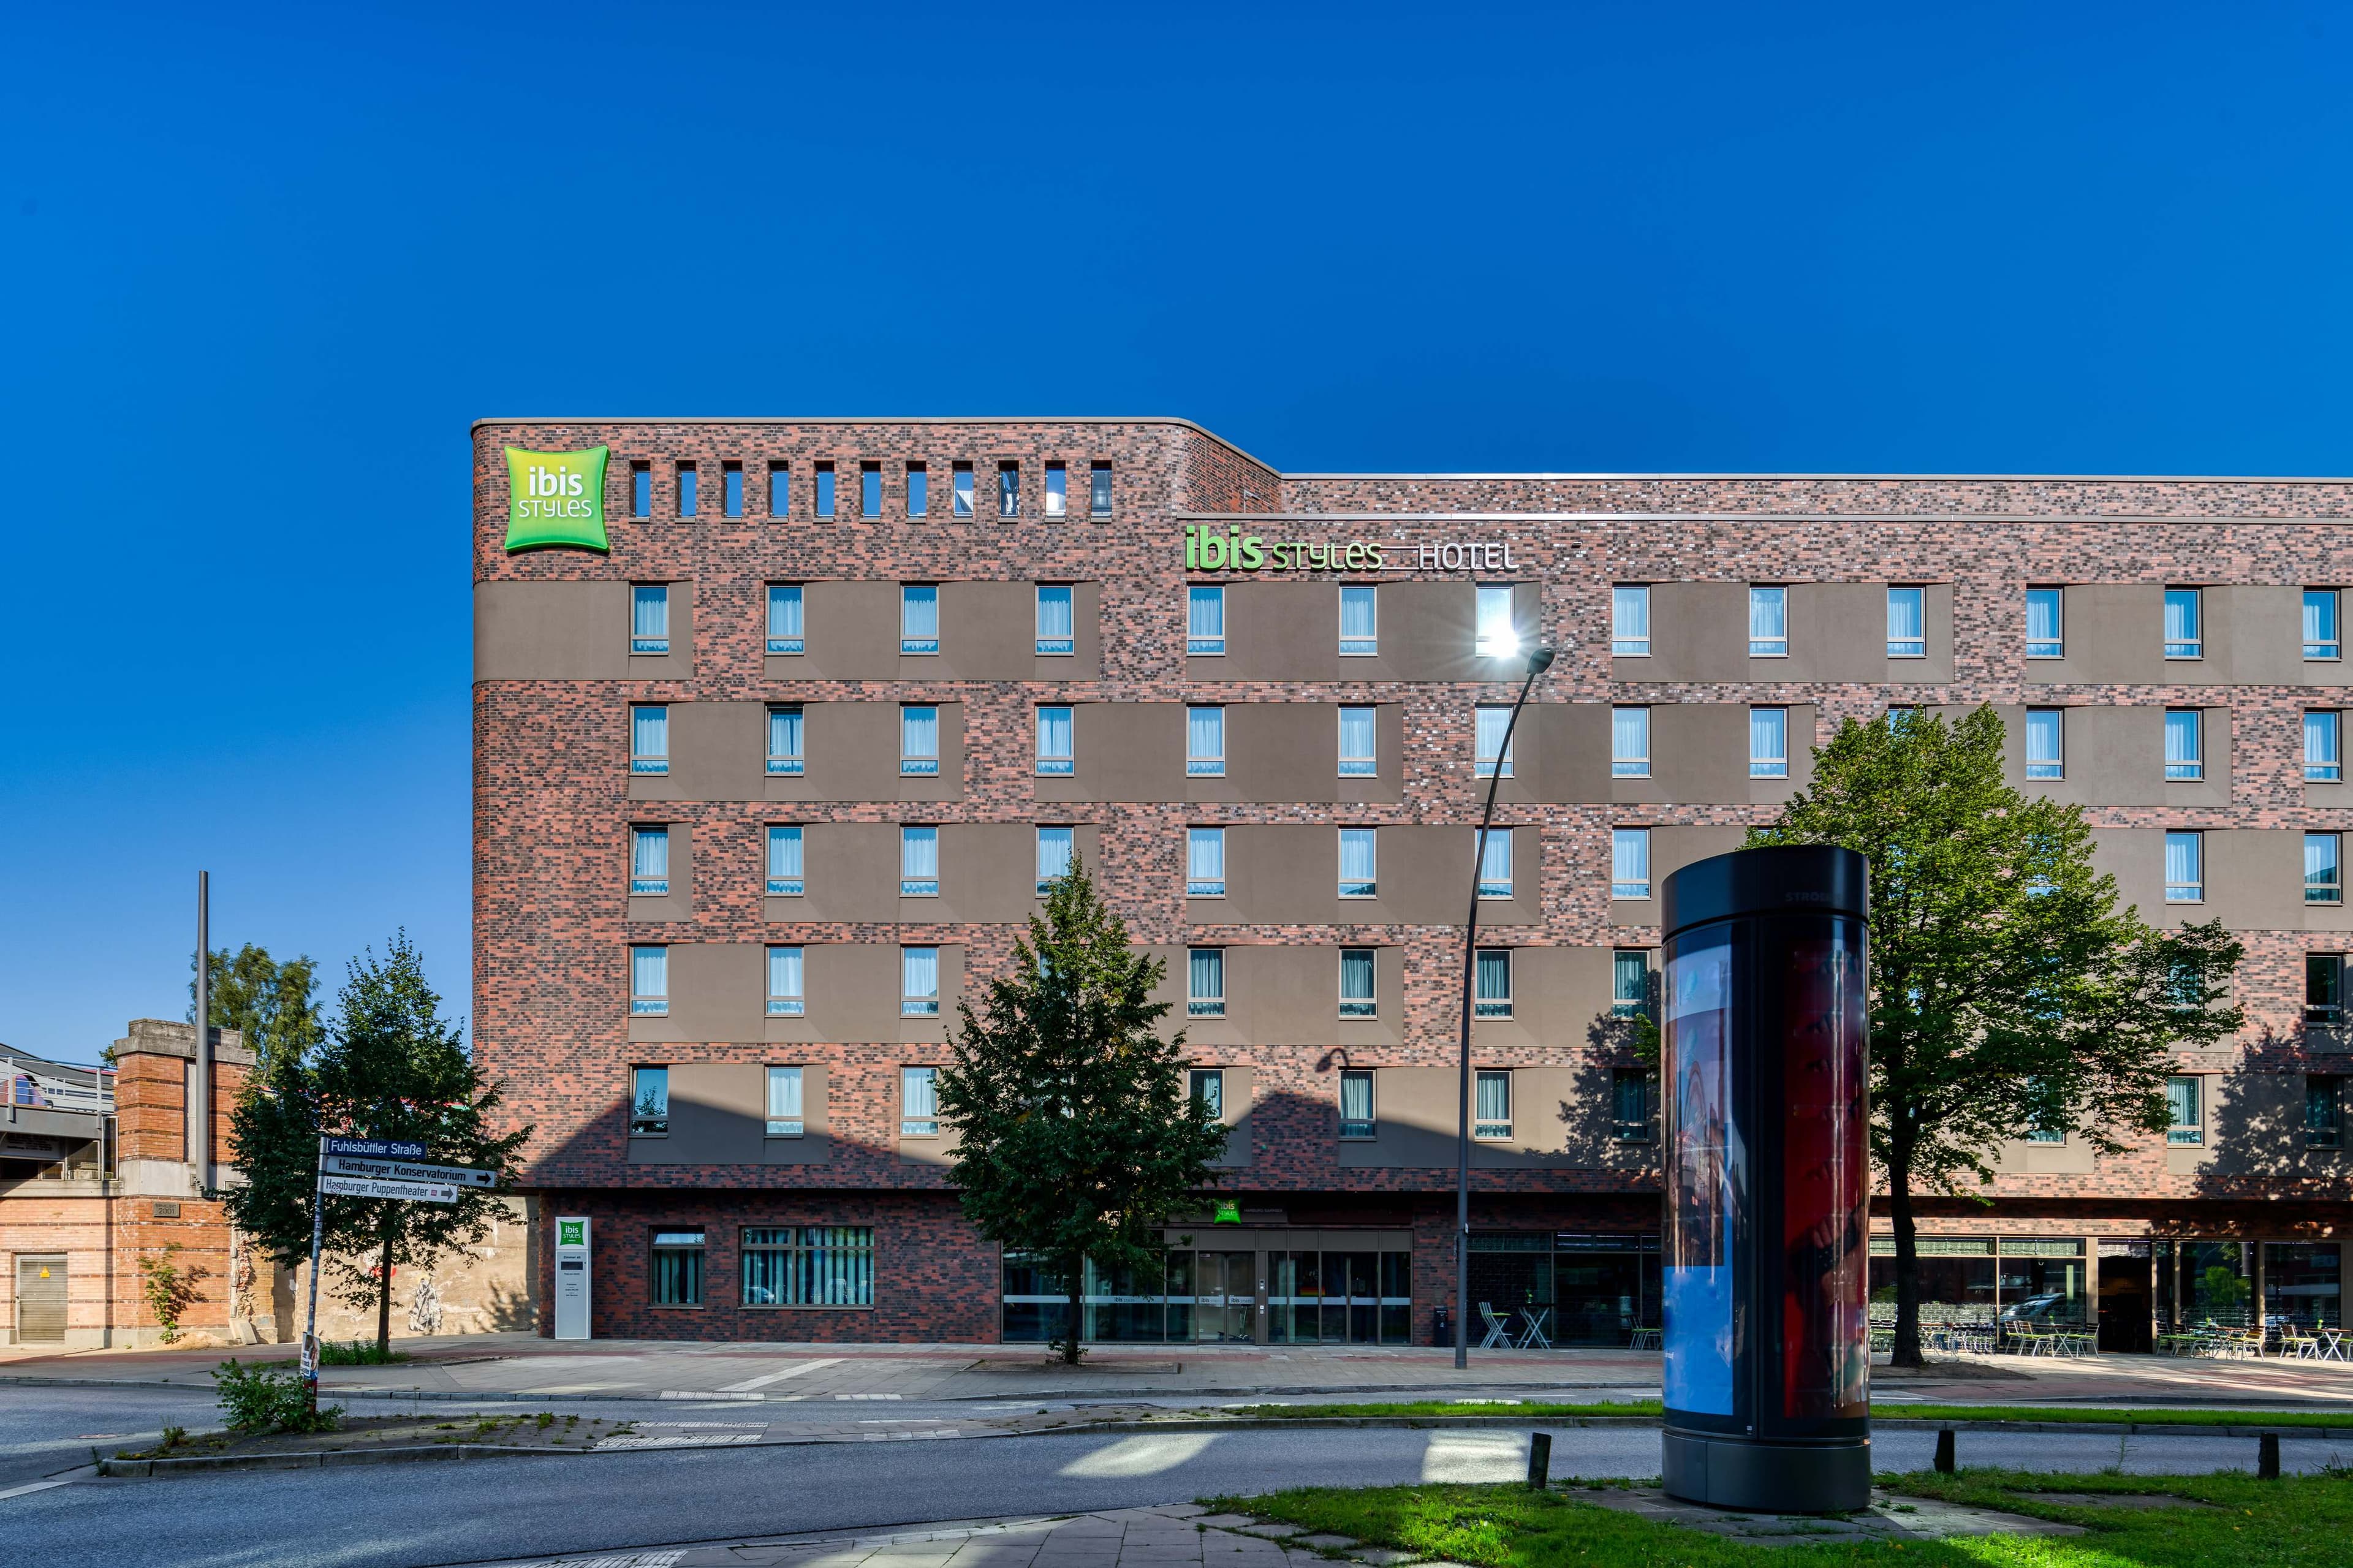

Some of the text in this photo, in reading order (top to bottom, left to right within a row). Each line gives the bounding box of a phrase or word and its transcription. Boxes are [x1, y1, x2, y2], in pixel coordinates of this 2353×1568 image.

[529, 466, 583, 496] ibis
[1186, 525, 1264, 570] ibis
[1419, 542, 1520, 570] HOTEL
[331, 1140, 422, 1156] Fuhlsbüttler Straße
[338, 1159, 466, 1181] Hamburger Konservatorium
[326, 1179, 369, 1194] Hamburger
[371, 1183, 428, 1197] Puppentheater
[1221, 1200, 1235, 1210] ibis
